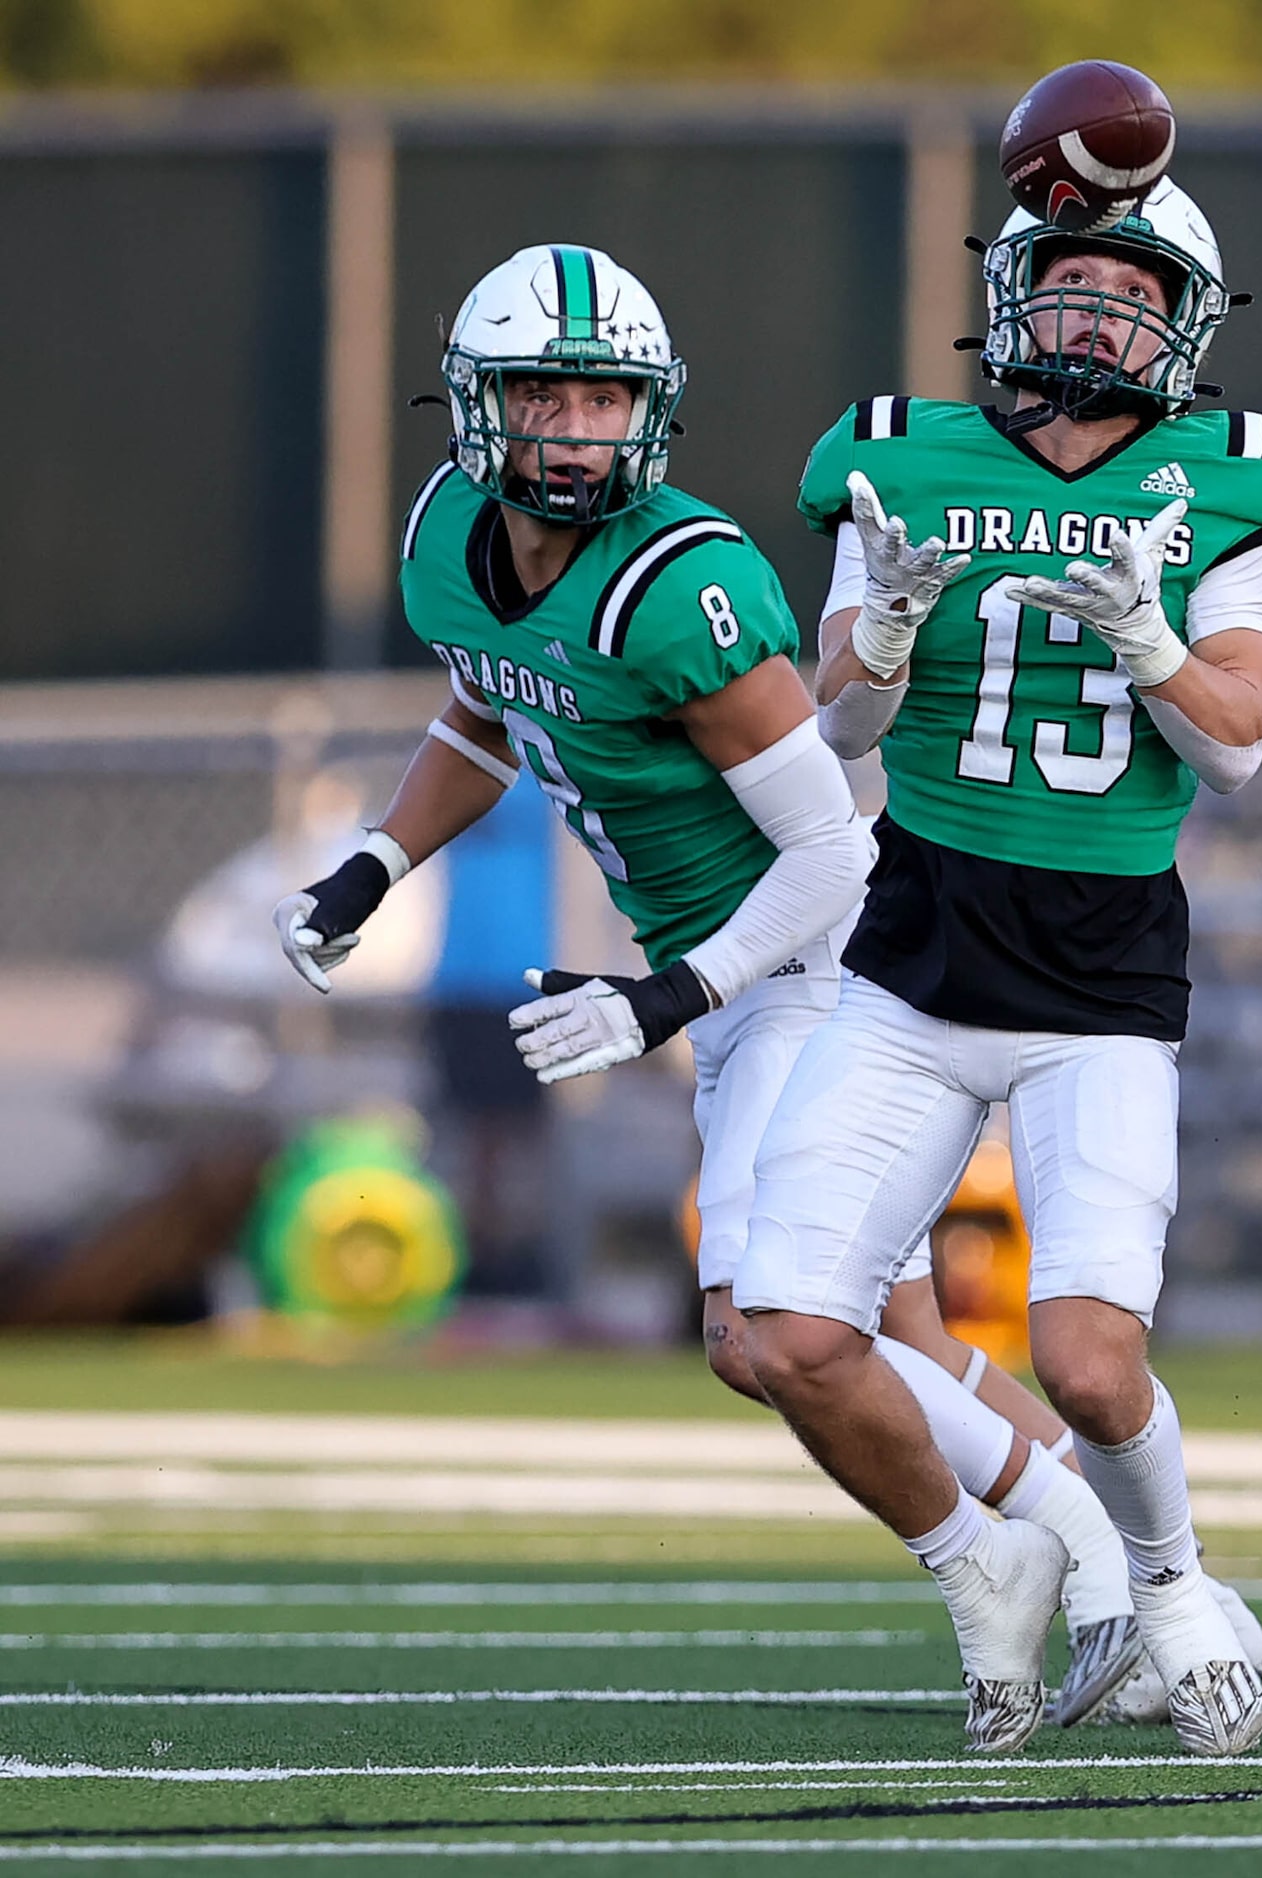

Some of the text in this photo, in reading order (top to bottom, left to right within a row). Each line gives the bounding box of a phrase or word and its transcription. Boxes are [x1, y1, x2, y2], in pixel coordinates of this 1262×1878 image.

[1140, 479, 1196, 498] adidas
[699, 582, 742, 651] 8
[955, 572, 1135, 798] 13
[501, 706, 630, 884] 8
